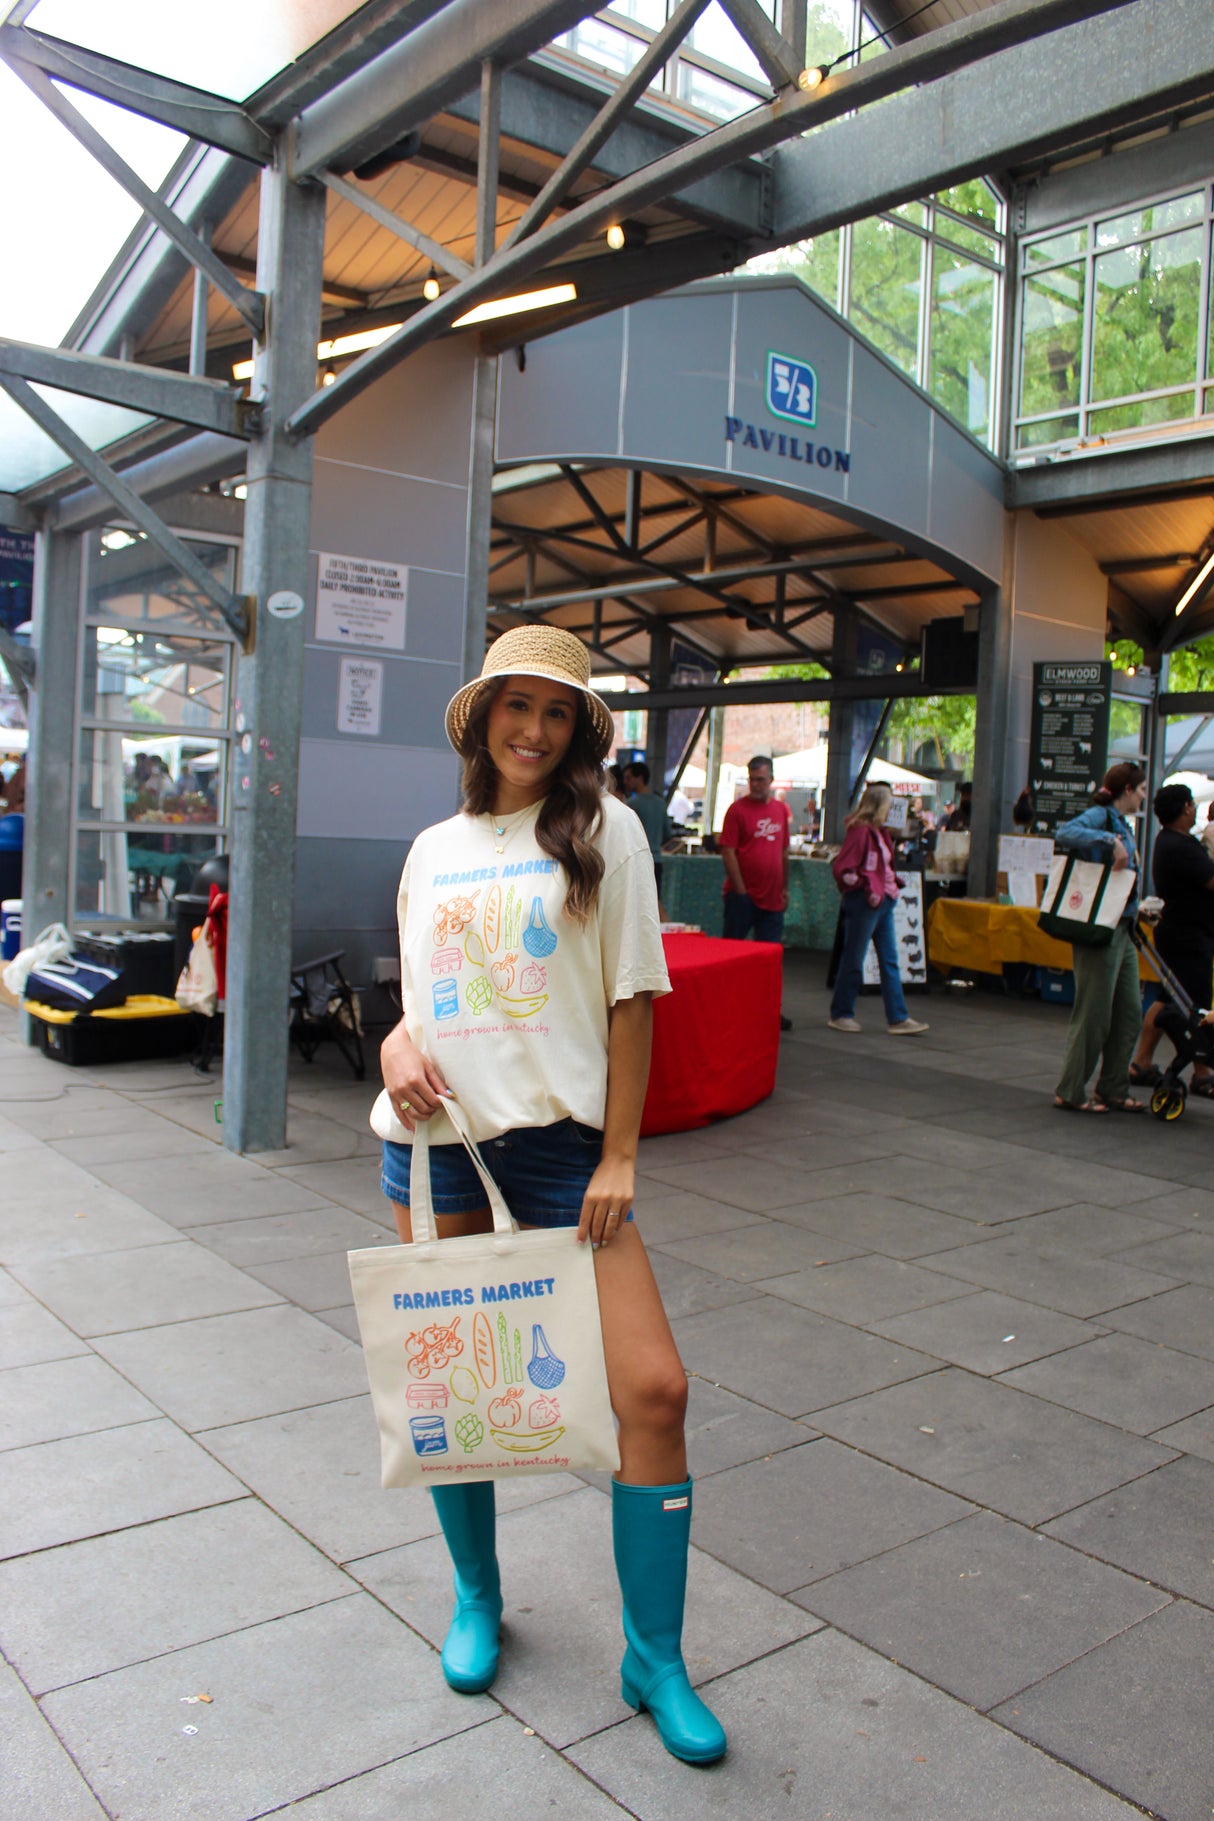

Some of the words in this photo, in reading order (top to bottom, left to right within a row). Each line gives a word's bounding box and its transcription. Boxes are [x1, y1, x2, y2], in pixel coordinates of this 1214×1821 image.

[725, 415, 851, 474] PAVILION
[325, 569, 348, 581] CLOSED
[370, 565, 398, 578] PAVILION
[320, 579, 338, 592] DAILY
[340, 583, 377, 598] PROHIBITED
[378, 588, 405, 600] ACTIVITY
[1045, 667, 1098, 680] ELMWOOD
[432, 866, 497, 887] FARMERS
[502, 859, 559, 879] MARKET
[436, 1027, 462, 1040] home
[463, 1025, 499, 1041] grown
[393, 1287, 475, 1310] FARMERS
[481, 1277, 556, 1304] MARKET
[420, 1463, 454, 1473] home
[455, 1461, 494, 1474] grown
[497, 1459, 510, 1469] in
[513, 1454, 572, 1469] kentucky
